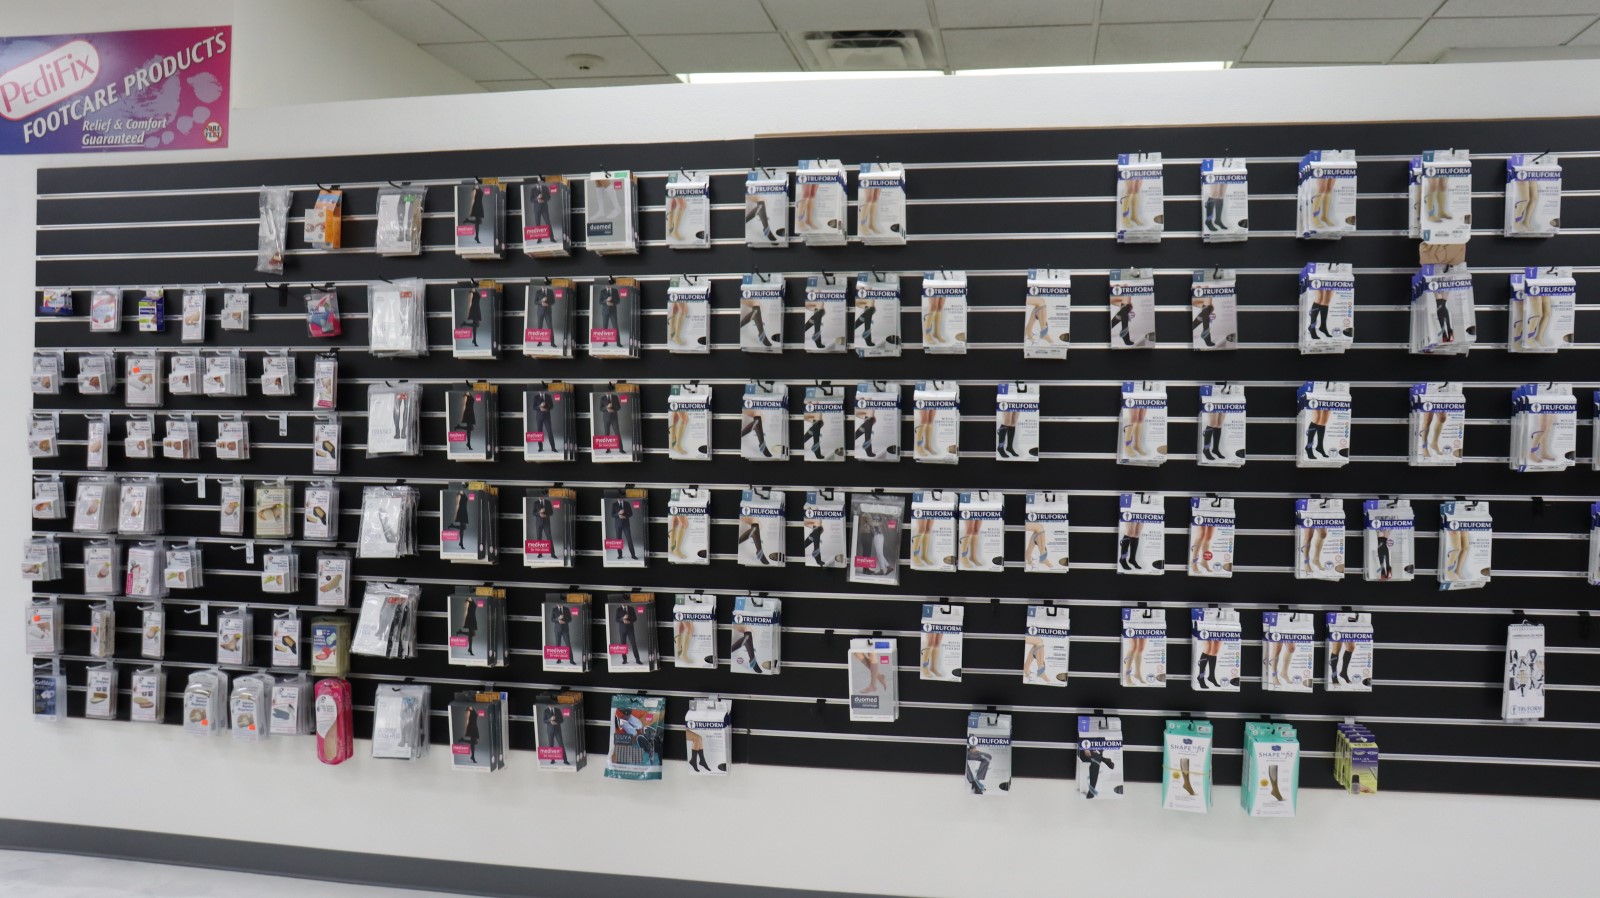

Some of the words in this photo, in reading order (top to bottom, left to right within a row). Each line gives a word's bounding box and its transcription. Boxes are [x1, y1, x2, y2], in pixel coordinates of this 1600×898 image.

[23, 83, 119, 144] FOOTCARE
[123, 32, 227, 96] PRODUCTS
[82, 118, 111, 131] Relief
[113, 120, 122, 131] &
[126, 117, 167, 131] Comfort
[82, 132, 145, 146] Guaranteed
[977, 737, 1009, 745] TRUFORM
